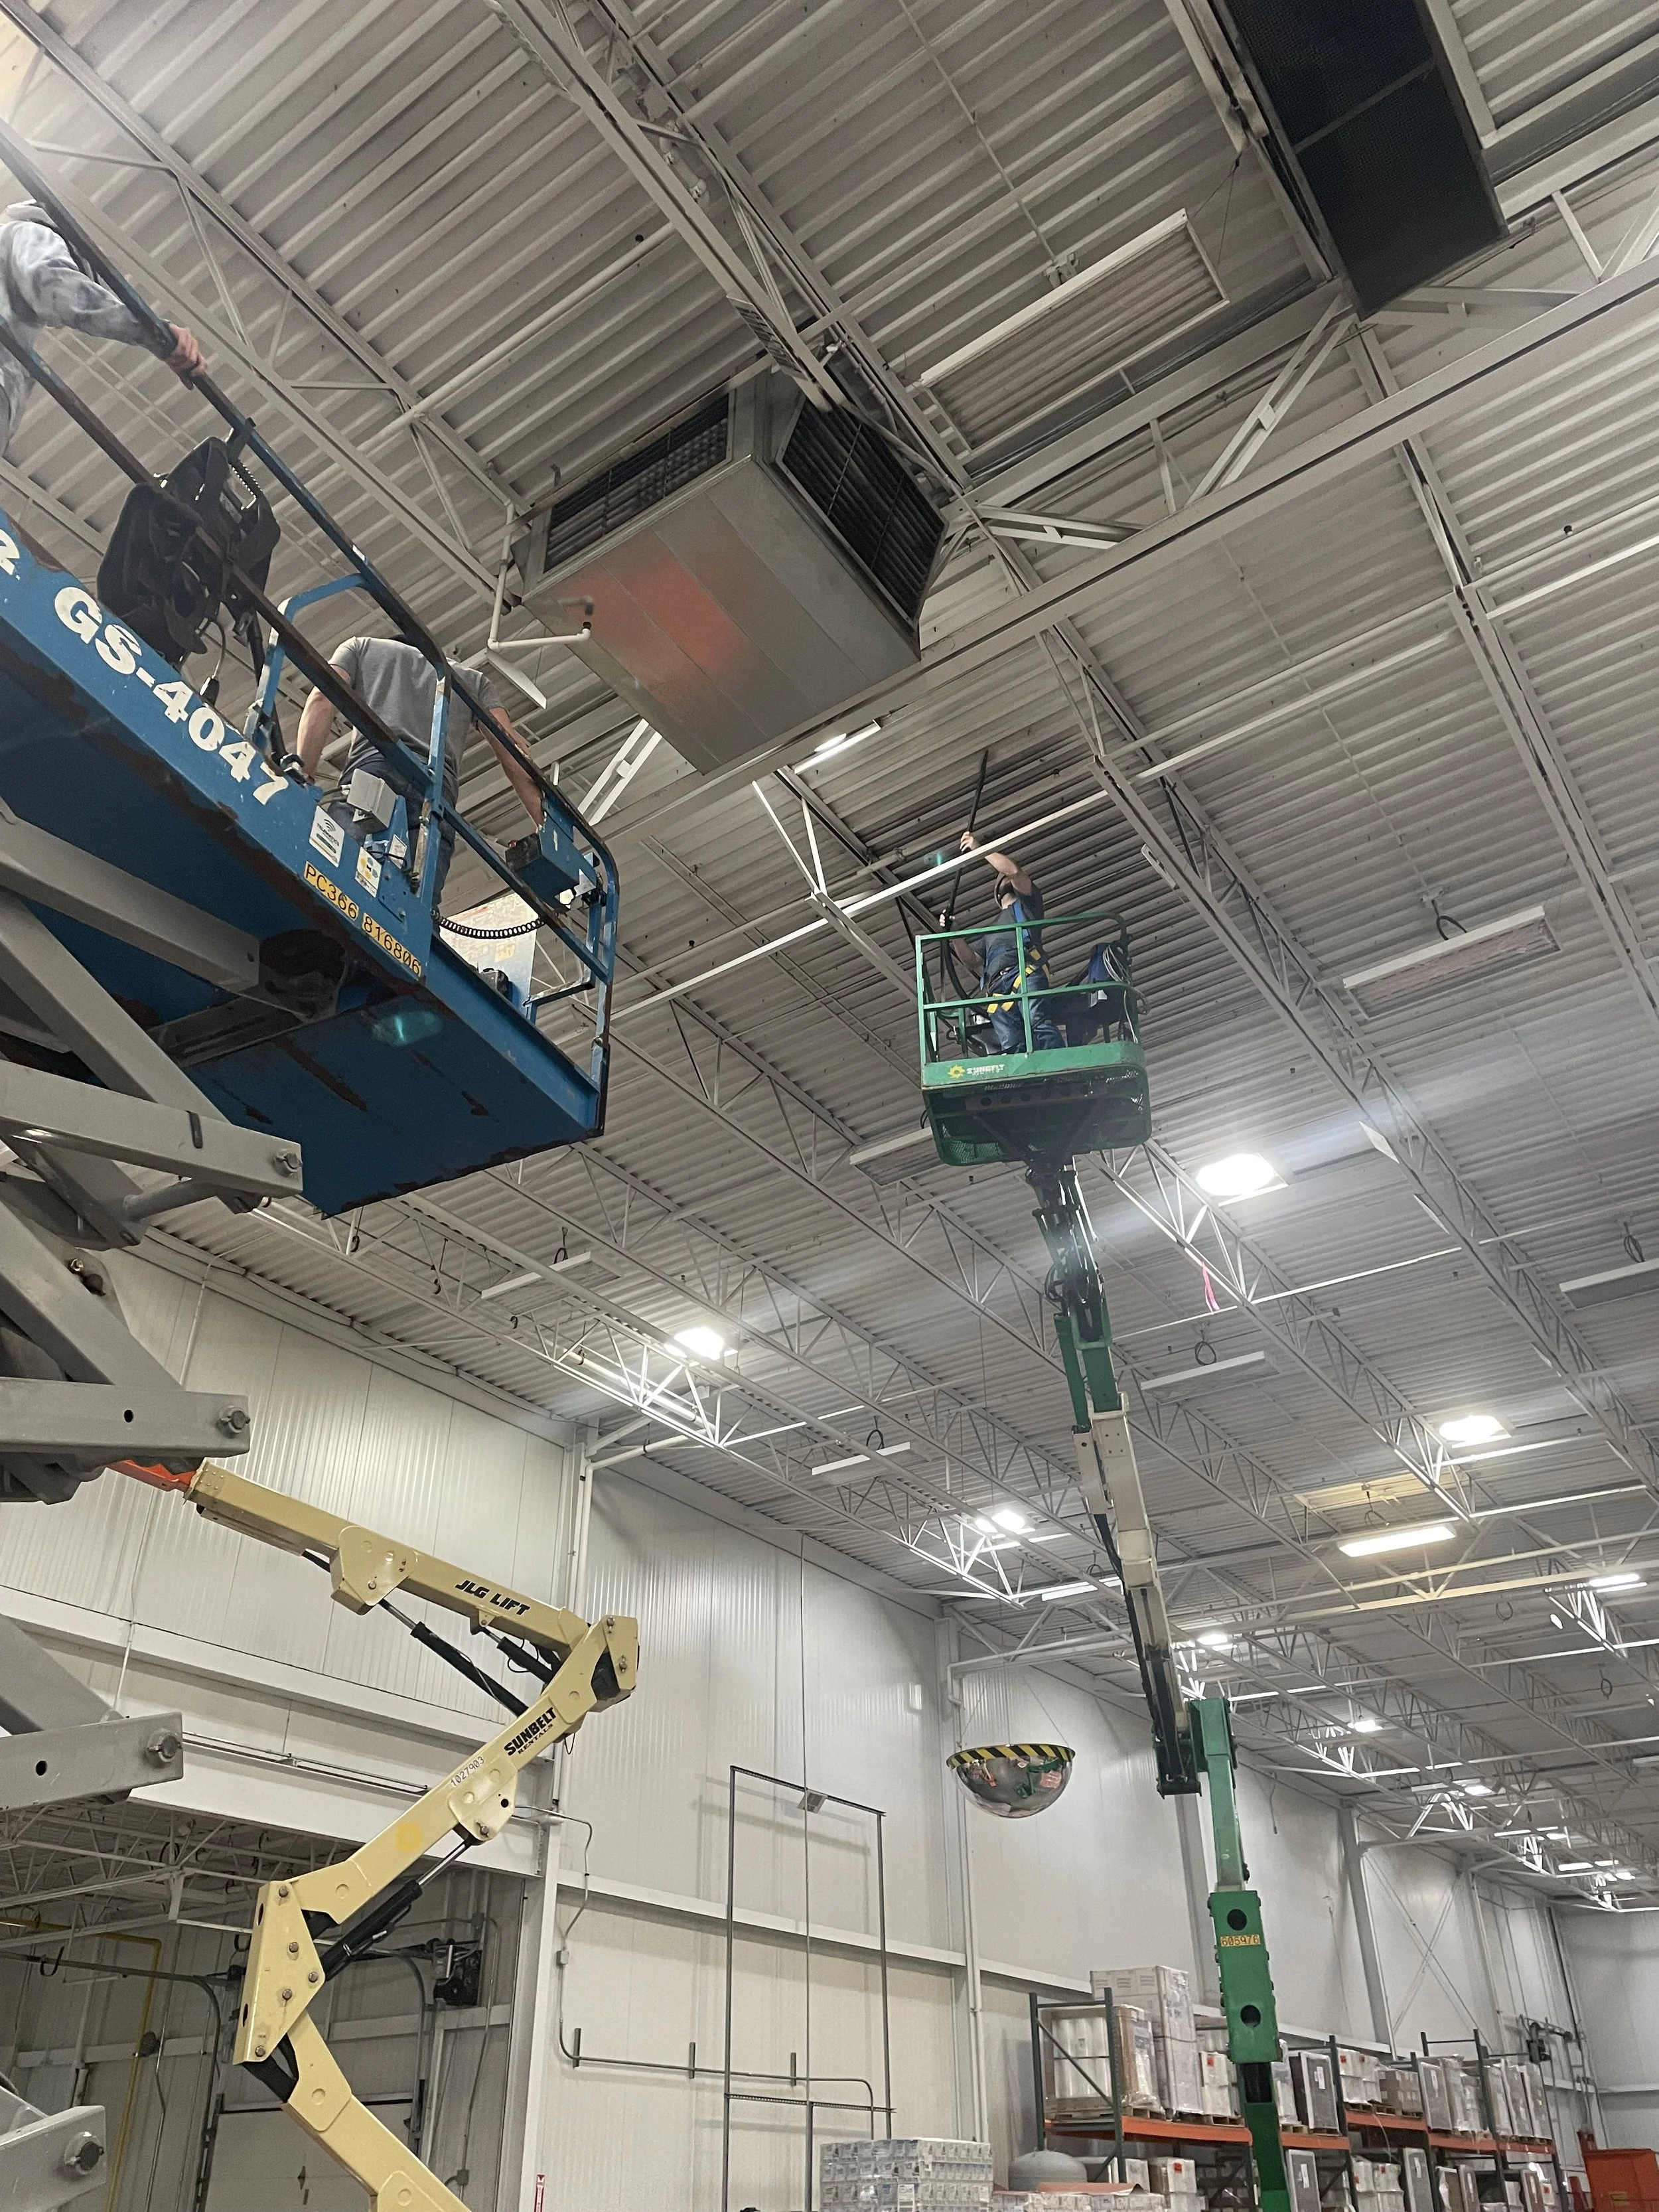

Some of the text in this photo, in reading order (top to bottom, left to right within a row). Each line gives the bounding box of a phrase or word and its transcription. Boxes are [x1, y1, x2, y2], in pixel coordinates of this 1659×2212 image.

[54, 587, 289, 805] GS-4047
[305, 864, 358, 919] PC366
[364, 916, 420, 974] 816806
[455, 1580, 530, 1615] JLG LIFT
[504, 1707, 556, 1756] SUNBELT
[517, 1724, 553, 1755] RENTALS
[450, 1756, 485, 1787] 1027903
